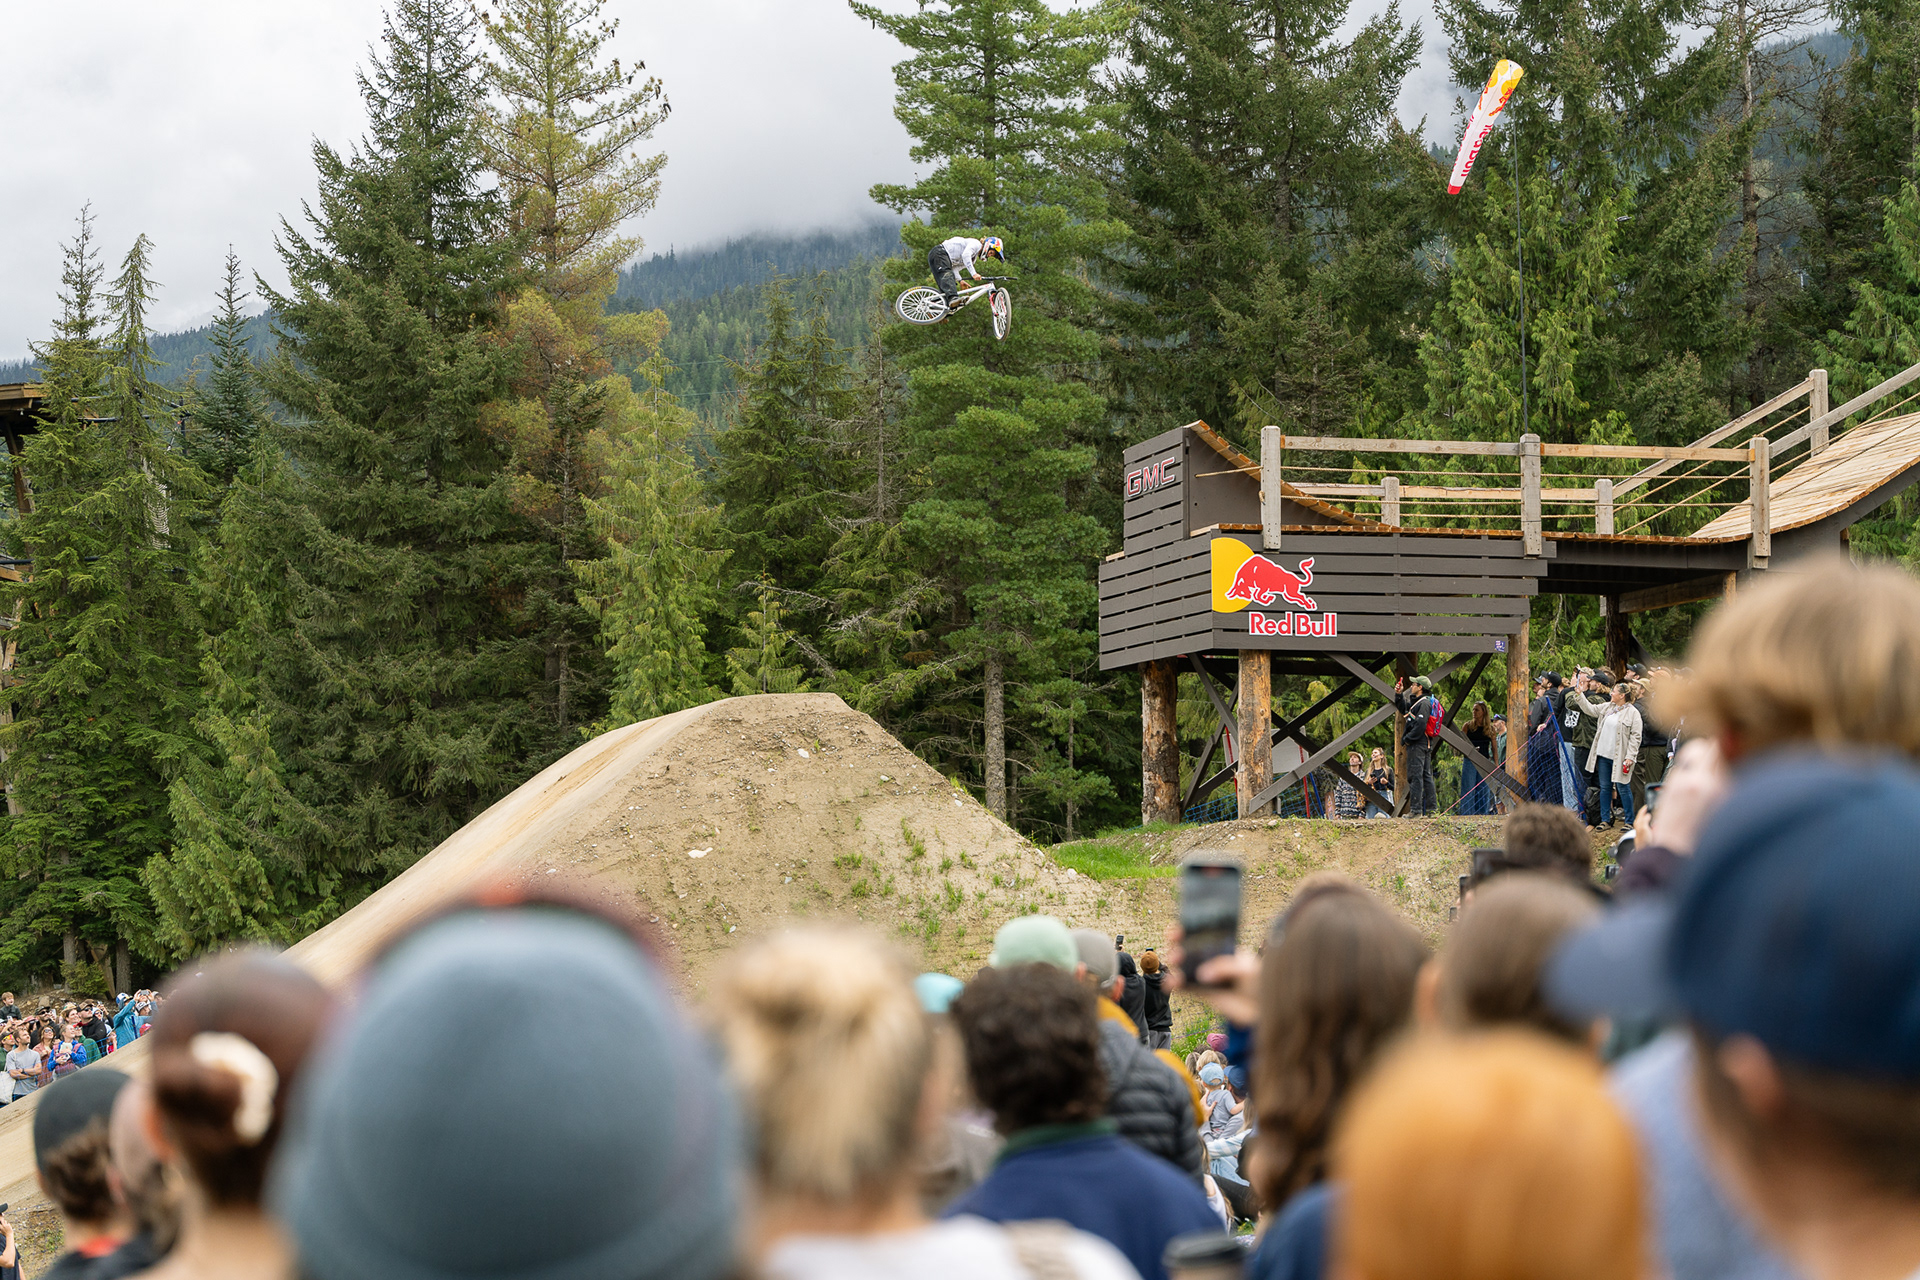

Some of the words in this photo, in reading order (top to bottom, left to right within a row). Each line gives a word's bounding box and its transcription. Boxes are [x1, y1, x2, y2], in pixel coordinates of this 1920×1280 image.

[1127, 457, 1175, 497] GMC
[1249, 612, 1292, 635] Red
[1295, 613, 1337, 637] Bull
